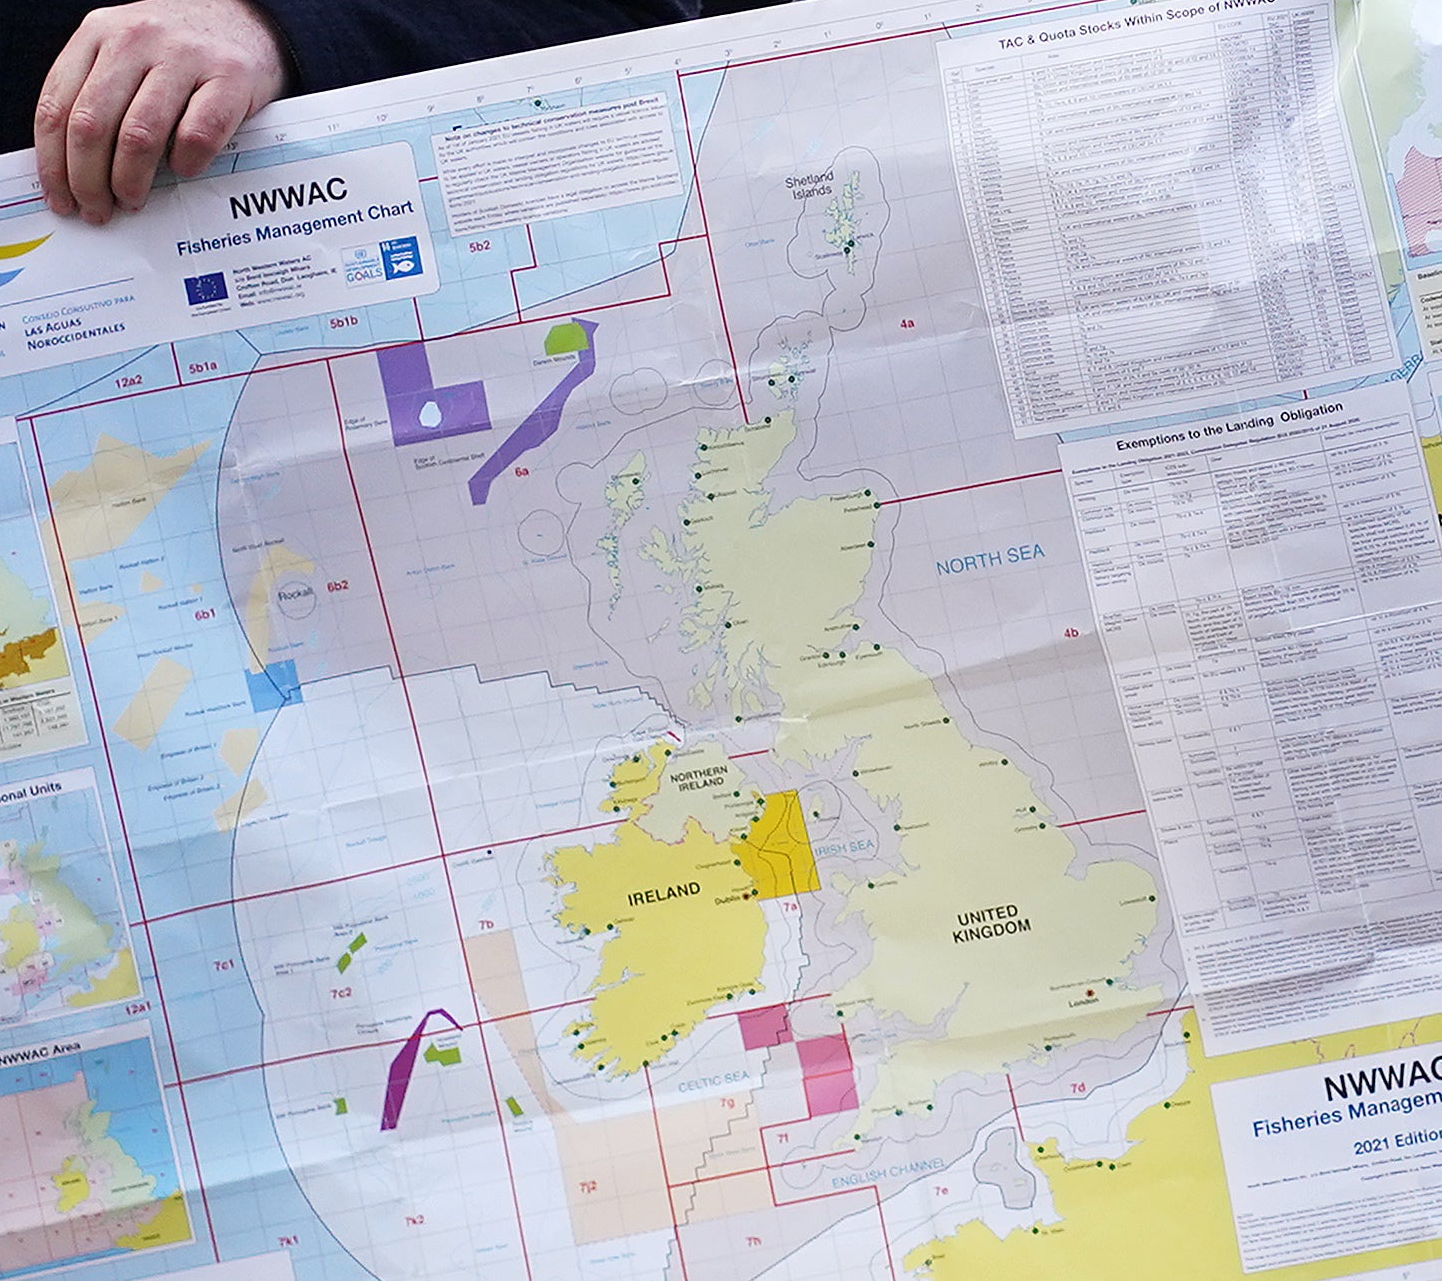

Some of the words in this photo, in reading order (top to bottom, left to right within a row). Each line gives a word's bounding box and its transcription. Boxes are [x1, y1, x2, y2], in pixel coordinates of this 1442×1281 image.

[999, 37, 1023, 49] TAC
[1027, 35, 1035, 44] &
[1039, 30, 1076, 42] Quota
[1079, 21, 1121, 35] Stocks
[1124, 14, 1162, 26] Within
[1166, 7, 1204, 20] Scope
[1207, 0, 1222, 14] of
[785, 169, 834, 191] Shetland
[230, 178, 347, 219] NWWAC
[793, 185, 832, 201] Islands
[177, 233, 251, 256] Fisheries
[256, 210, 364, 241] Management
[368, 201, 414, 219] Chart
[470, 240, 490, 253] 5b2
[25, 326, 43, 337] LAS
[46, 317, 81, 333] AGUAS
[330, 316, 358, 329] 5b1b
[901, 319, 914, 328] 4a
[28, 323, 125, 350] NOROCCIDENTALES
[189, 362, 217, 374] 5b1a
[115, 375, 142, 388] 12a2
[1117, 433, 1185, 450] Exemptions
[1187, 427, 1202, 440] to
[1204, 426, 1222, 436] the
[1226, 417, 1274, 432] Landing
[1281, 403, 1343, 422] Obligation
[515, 467, 529, 477] 6a
[937, 551, 1002, 576] NORTH
[1007, 544, 1045, 563] SEA
[327, 580, 348, 592] 6b2
[195, 608, 215, 621] 6b1
[1065, 628, 1079, 638] 4b
[670, 766, 728, 784] NORTHERN
[30, 783, 62, 796] Units
[679, 777, 724, 791] IRELAND
[628, 882, 700, 906] IRELAND
[783, 902, 797, 912] 7a
[958, 905, 1018, 926] UNITED
[479, 920, 494, 930] 7b
[953, 919, 1031, 943] KINGDOM
[214, 959, 234, 971] 7c1
[330, 987, 351, 999] 7c2
[53, 1043, 81, 1054] Area
[1070, 1082, 1085, 1093] 7d
[720, 1098, 735, 1109] 7g
[1253, 1110, 1342, 1137] Fisheries
[1354, 1137, 1389, 1155] 2021
[935, 1186, 948, 1196] 7e
[747, 1237, 761, 1246] 7h
